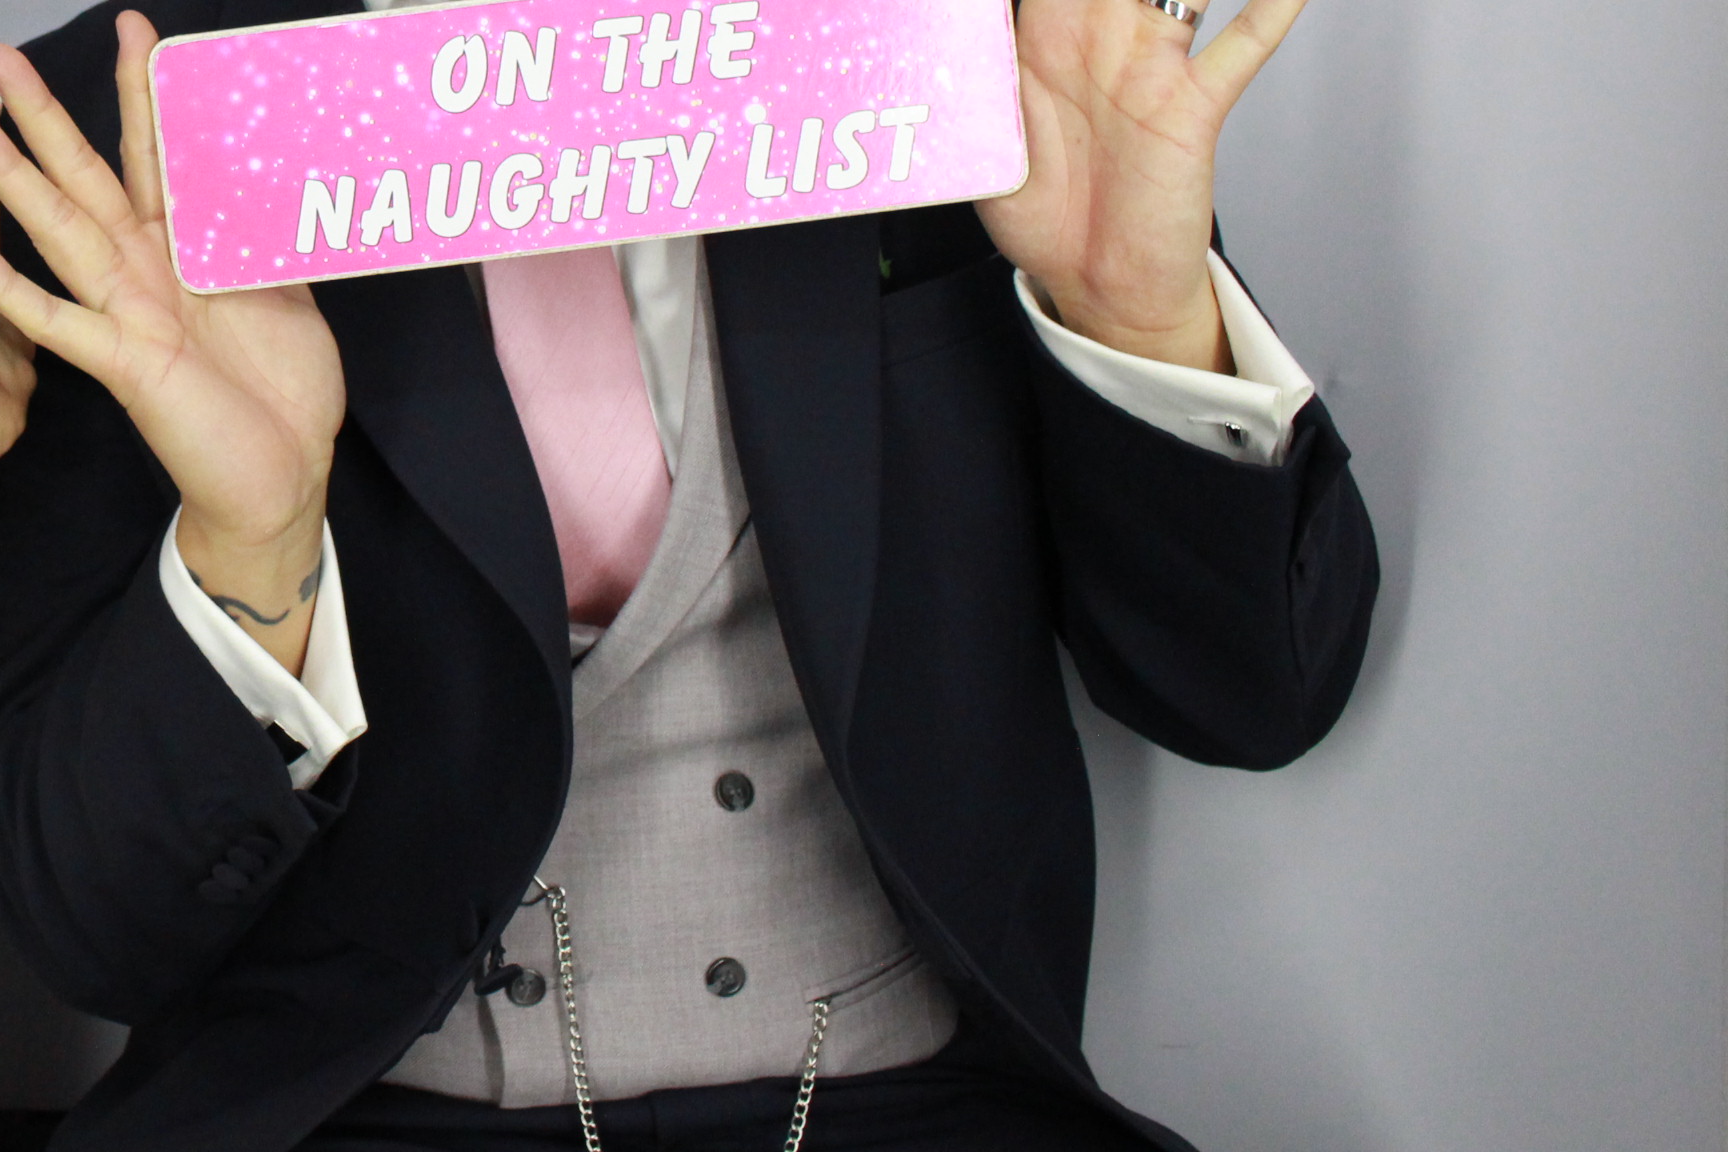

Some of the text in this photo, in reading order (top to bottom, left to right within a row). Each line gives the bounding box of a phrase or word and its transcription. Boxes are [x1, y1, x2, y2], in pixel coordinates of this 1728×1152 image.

[430, 0, 761, 115] ON THE
[293, 103, 932, 255] NAUGHTY LIST
